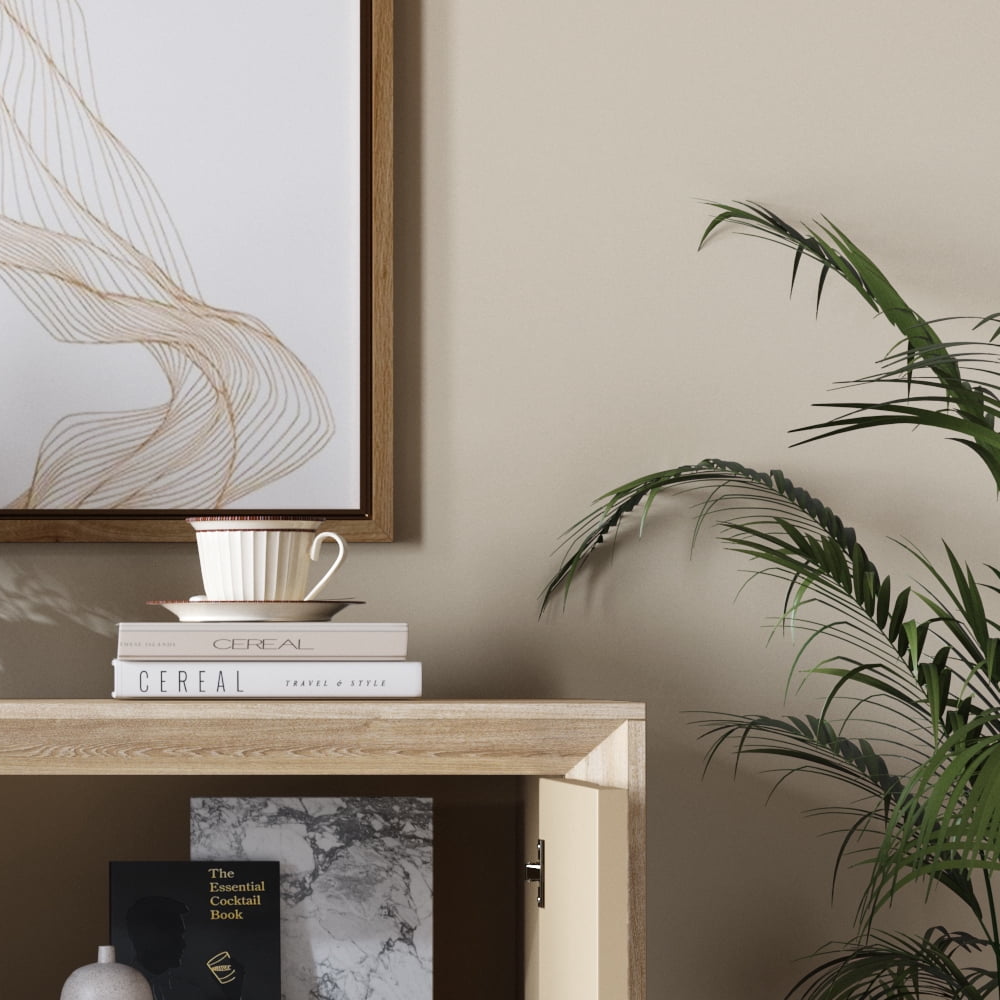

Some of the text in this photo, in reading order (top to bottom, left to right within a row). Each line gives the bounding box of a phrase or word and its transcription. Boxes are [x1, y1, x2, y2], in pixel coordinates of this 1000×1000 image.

[212, 638, 314, 650] CEREAL
[139, 670, 244, 692] CEREAL
[285, 679, 329, 687] TRAVEL
[350, 679, 387, 687] STYLE
[208, 868, 235, 879] The
[209, 881, 265, 892] Essential
[210, 895, 261, 906] Cocktail
[210, 909, 243, 920] Book
